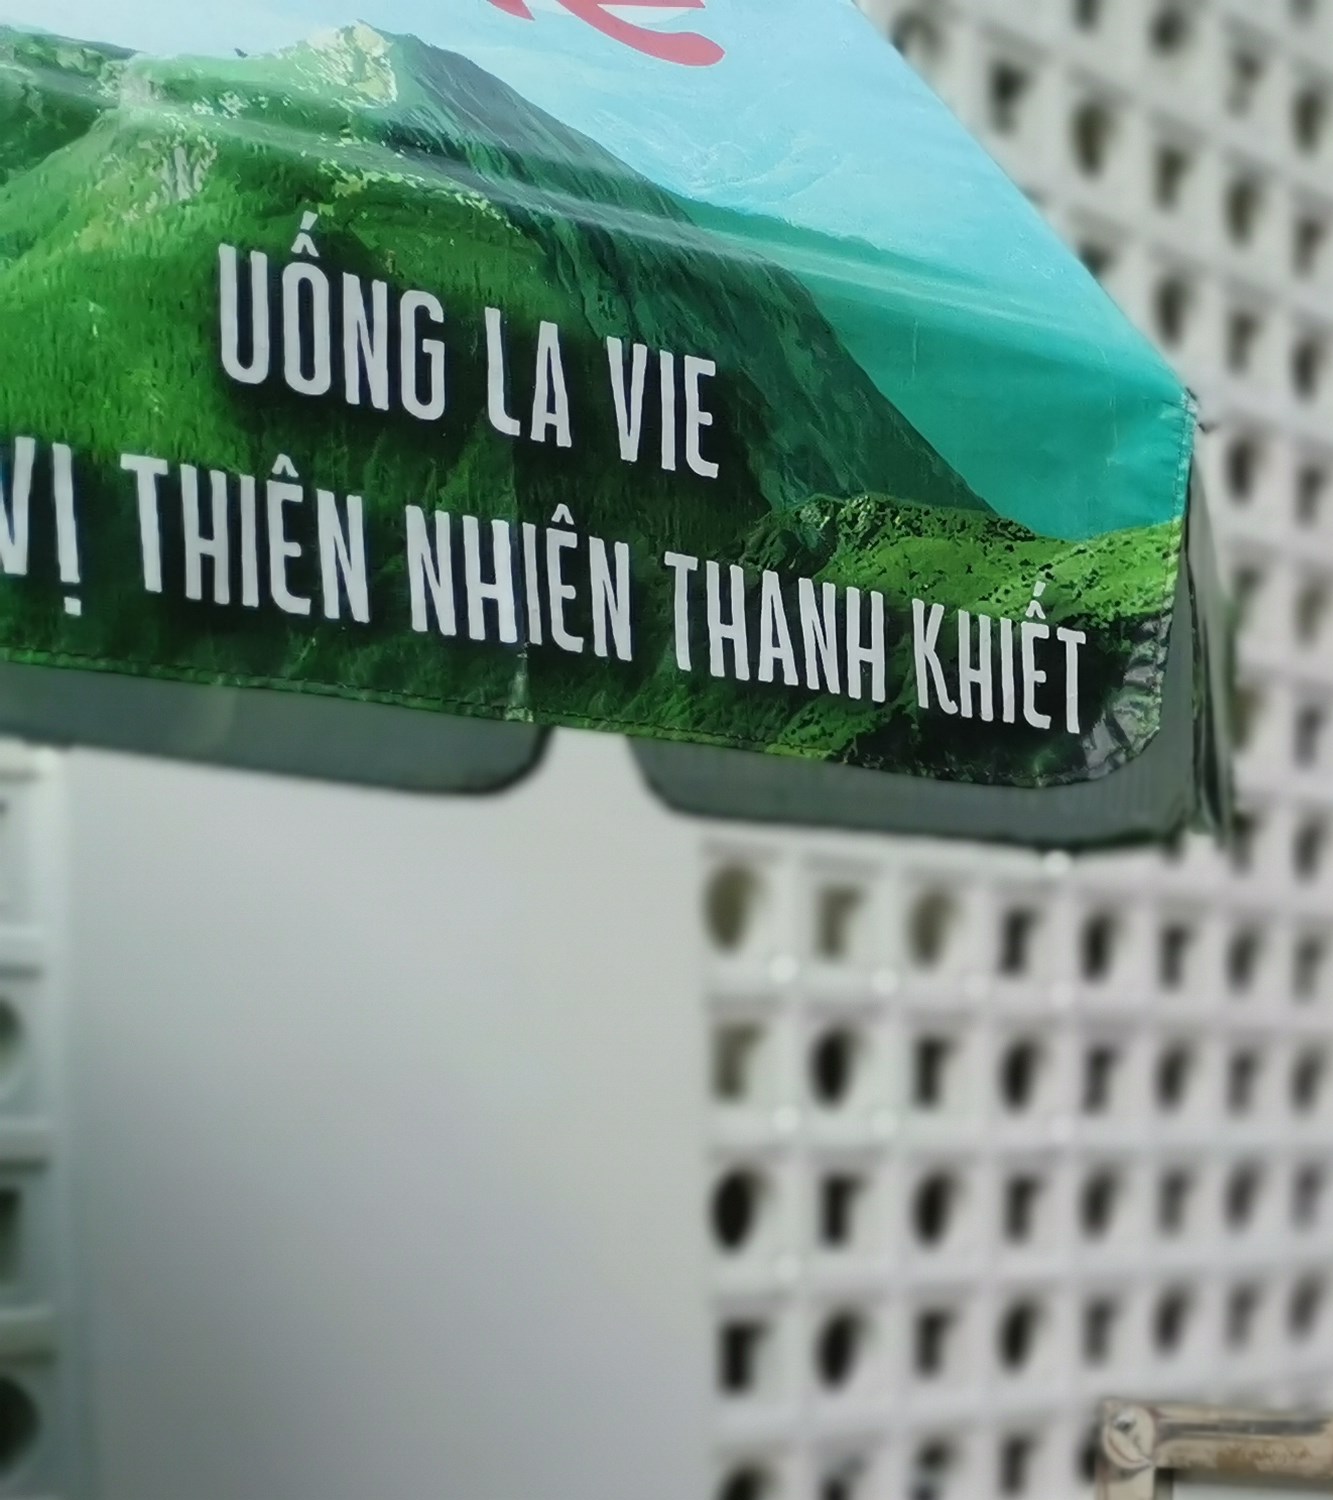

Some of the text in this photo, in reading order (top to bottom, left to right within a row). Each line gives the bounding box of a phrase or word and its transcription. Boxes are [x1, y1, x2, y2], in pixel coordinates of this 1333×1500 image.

[219, 211, 719, 479] UỐNG LA VIE
[120, 453, 369, 623] THIÊN
[405, 503, 632, 662] NHIÊN
[664, 552, 886, 703] THANH
[911, 582, 1086, 734] KHIẾT
